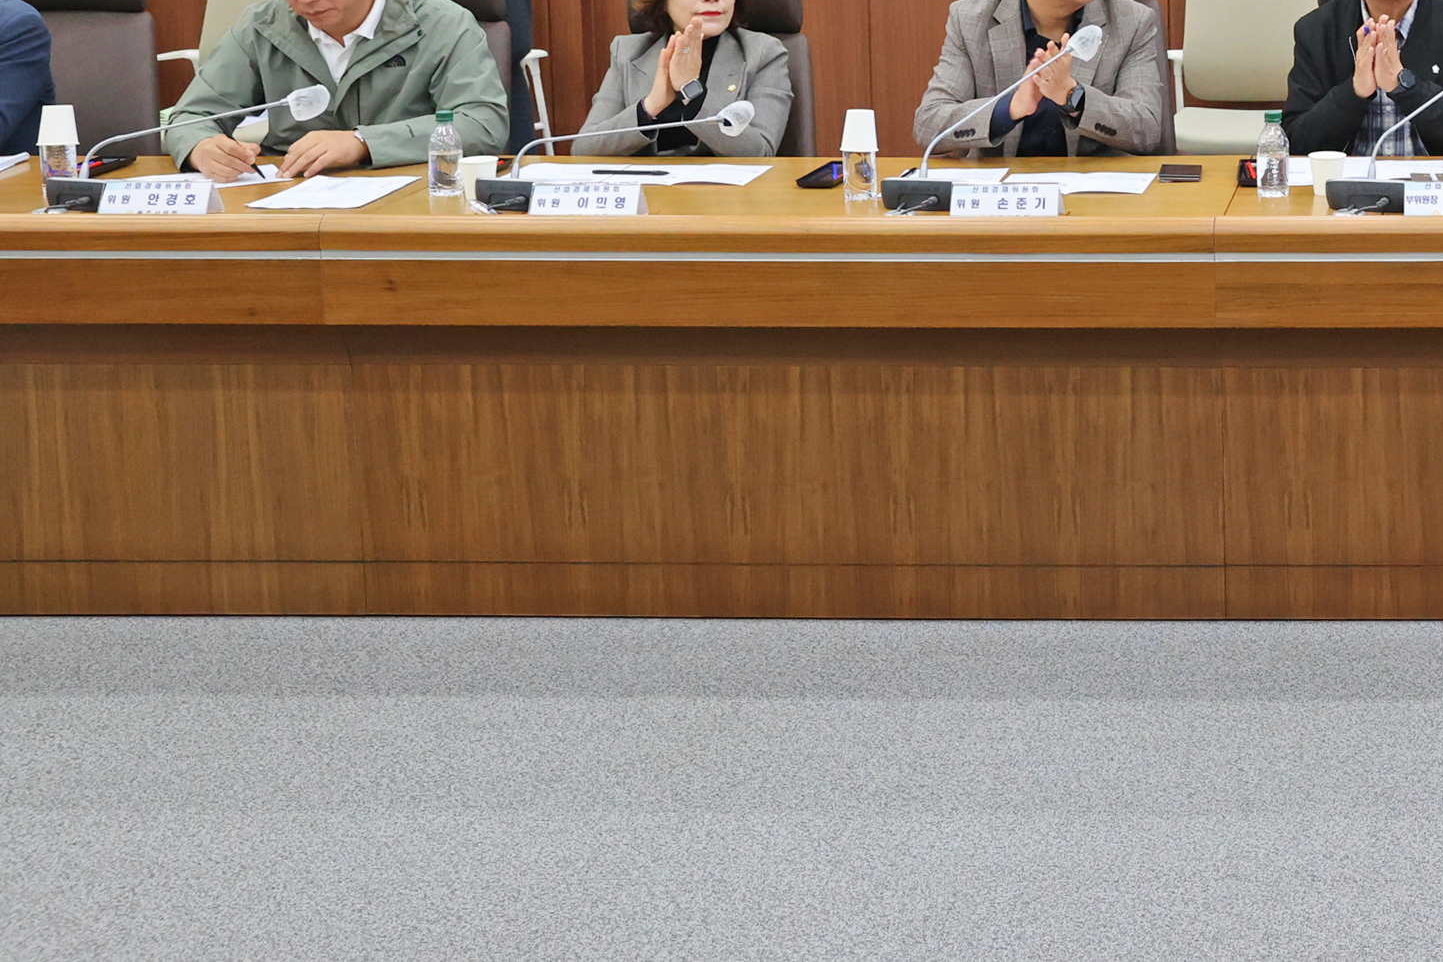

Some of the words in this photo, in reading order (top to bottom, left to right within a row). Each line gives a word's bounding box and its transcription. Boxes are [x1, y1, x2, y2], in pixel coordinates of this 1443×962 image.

[107, 195, 131, 204] 위원
[147, 193, 196, 205] 안경호
[537, 198, 560, 208] 위원
[577, 197, 625, 209] 이민영
[957, 199, 980, 209] 위원
[997, 197, 1046, 210] 손준기
[1406, 195, 1438, 205] 부위원장
